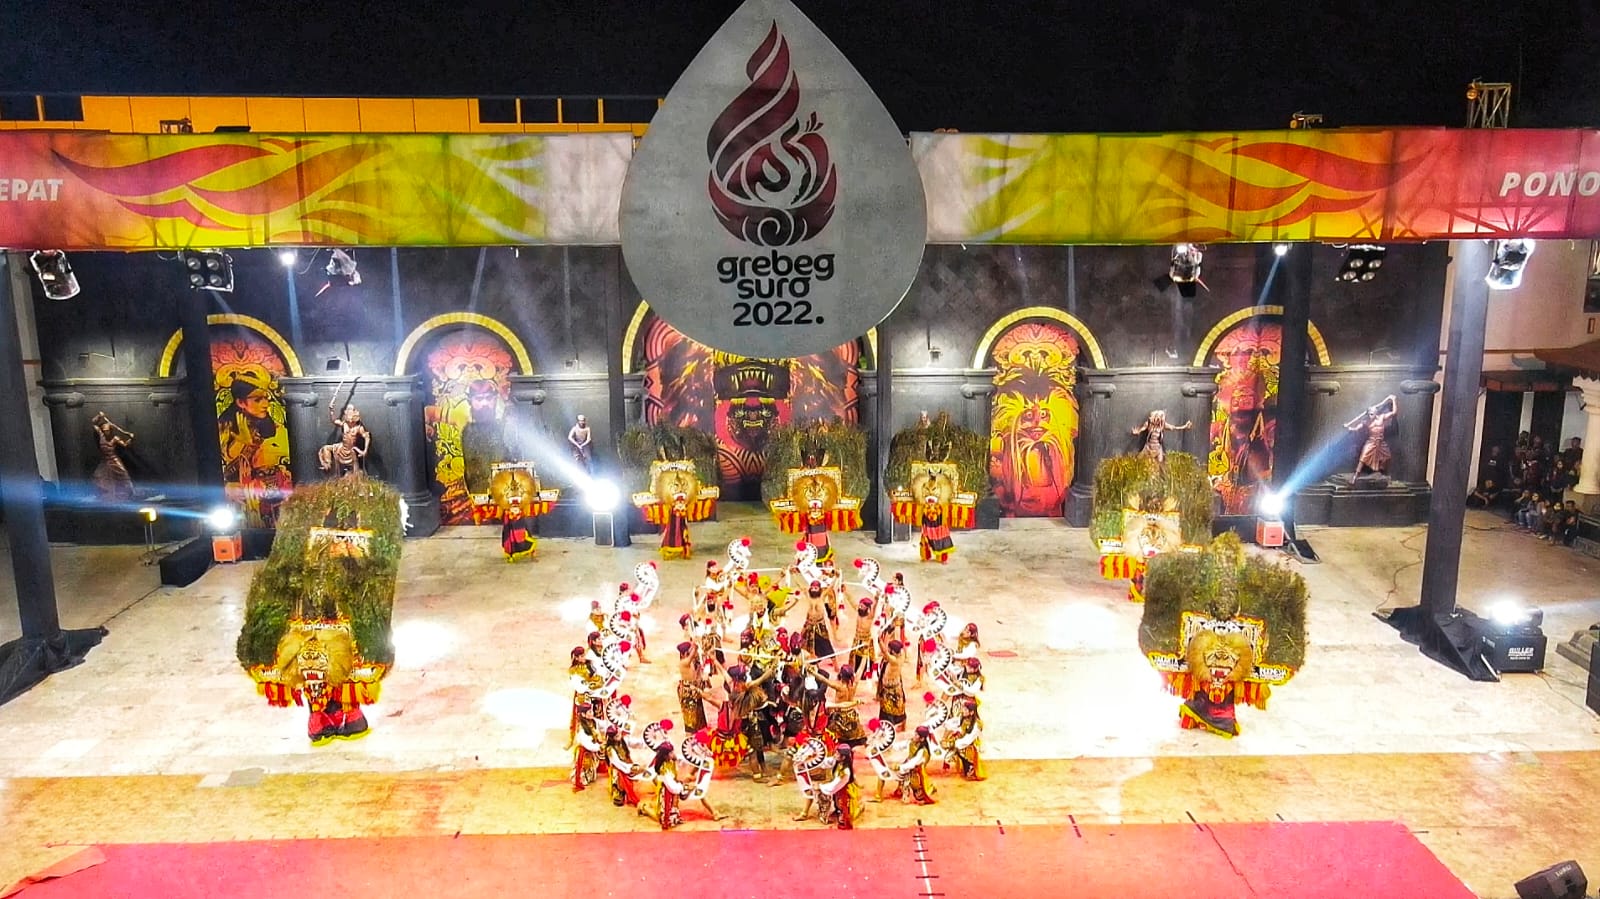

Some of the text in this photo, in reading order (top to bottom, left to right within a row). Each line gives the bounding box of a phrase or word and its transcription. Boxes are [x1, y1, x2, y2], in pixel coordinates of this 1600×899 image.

[0, 178, 64, 201] EPAT
[1499, 171, 1600, 197] PONO
[717, 249, 836, 284] grebeg
[737, 276, 812, 300] sura
[732, 300, 825, 327] 2022.
